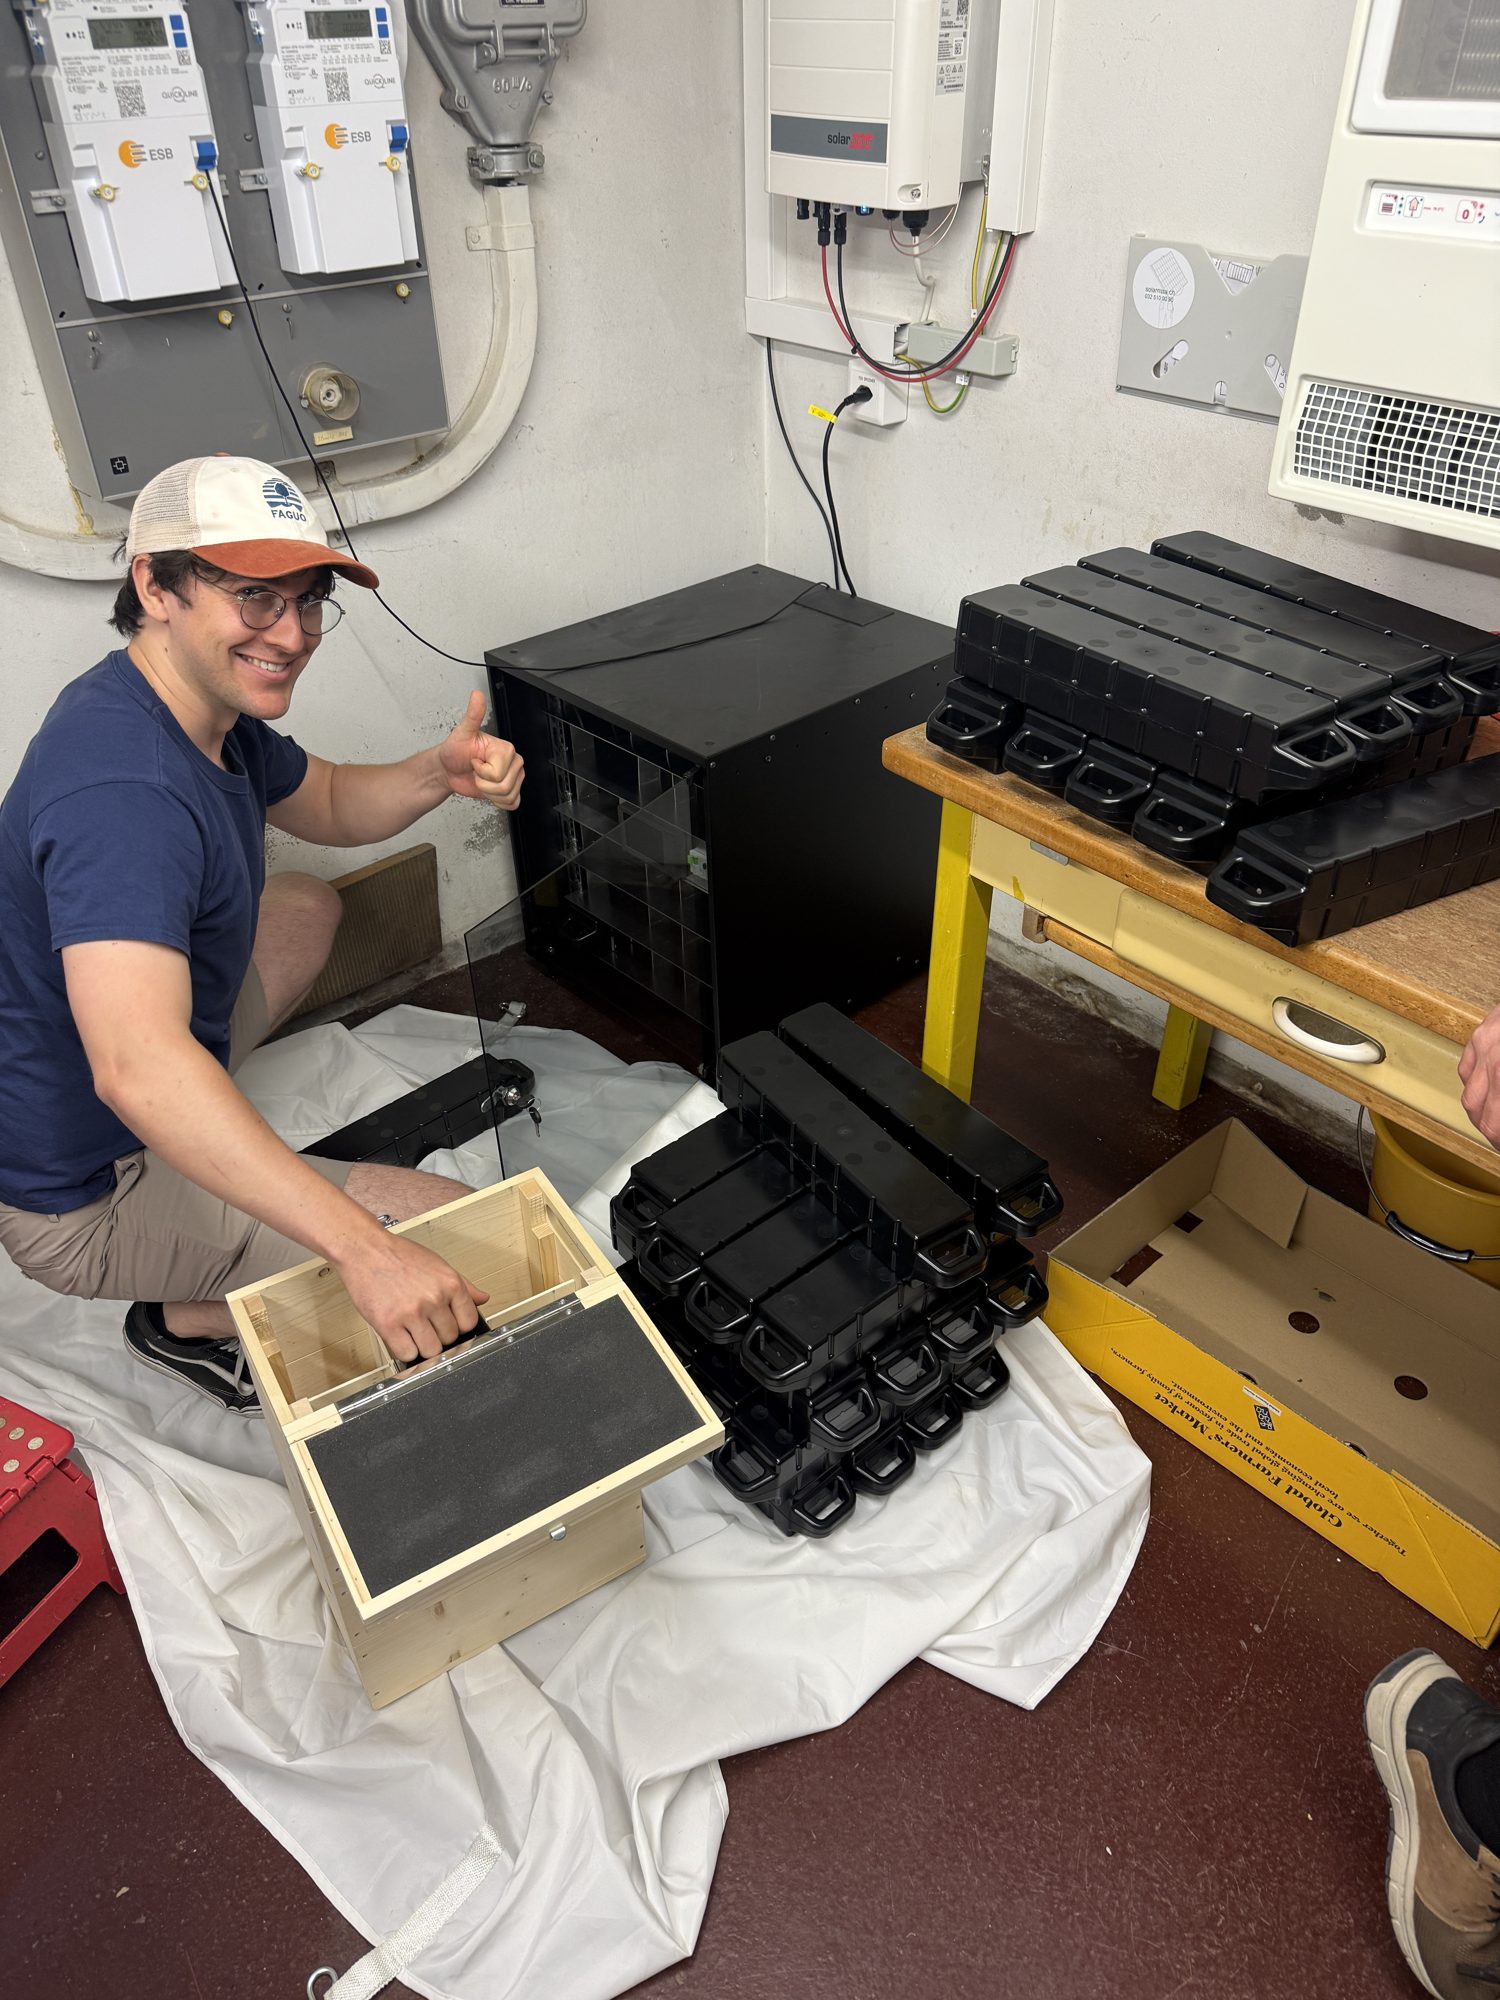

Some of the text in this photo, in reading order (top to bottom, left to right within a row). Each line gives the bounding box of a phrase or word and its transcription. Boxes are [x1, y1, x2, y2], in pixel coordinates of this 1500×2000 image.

[351, 132, 371, 143] ESB
[150, 148, 173, 161] ESB
[271, 510, 307, 522] FAGUO
[1145, 1372, 1175, 1394] family
[1172, 1392, 1183, 1400] of
[1153, 1391, 1209, 1435] Market
[1183, 1400, 1216, 1422] favour
[1214, 1419, 1224, 1430] in
[1228, 1420, 1243, 1433] the
[1225, 1428, 1250, 1447] trade
[1244, 1431, 1263, 1446] and
[1250, 1445, 1281, 1468] global
[1264, 1445, 1313, 1480] economies
[1280, 1465, 1325, 1498] changing
[1313, 1479, 1339, 1500] local
[1284, 1483, 1342, 1528] Global
[1326, 1497, 1344, 1511] are
[1345, 1511, 1360, 1523] we
[1361, 1523, 1406, 1557] Together
